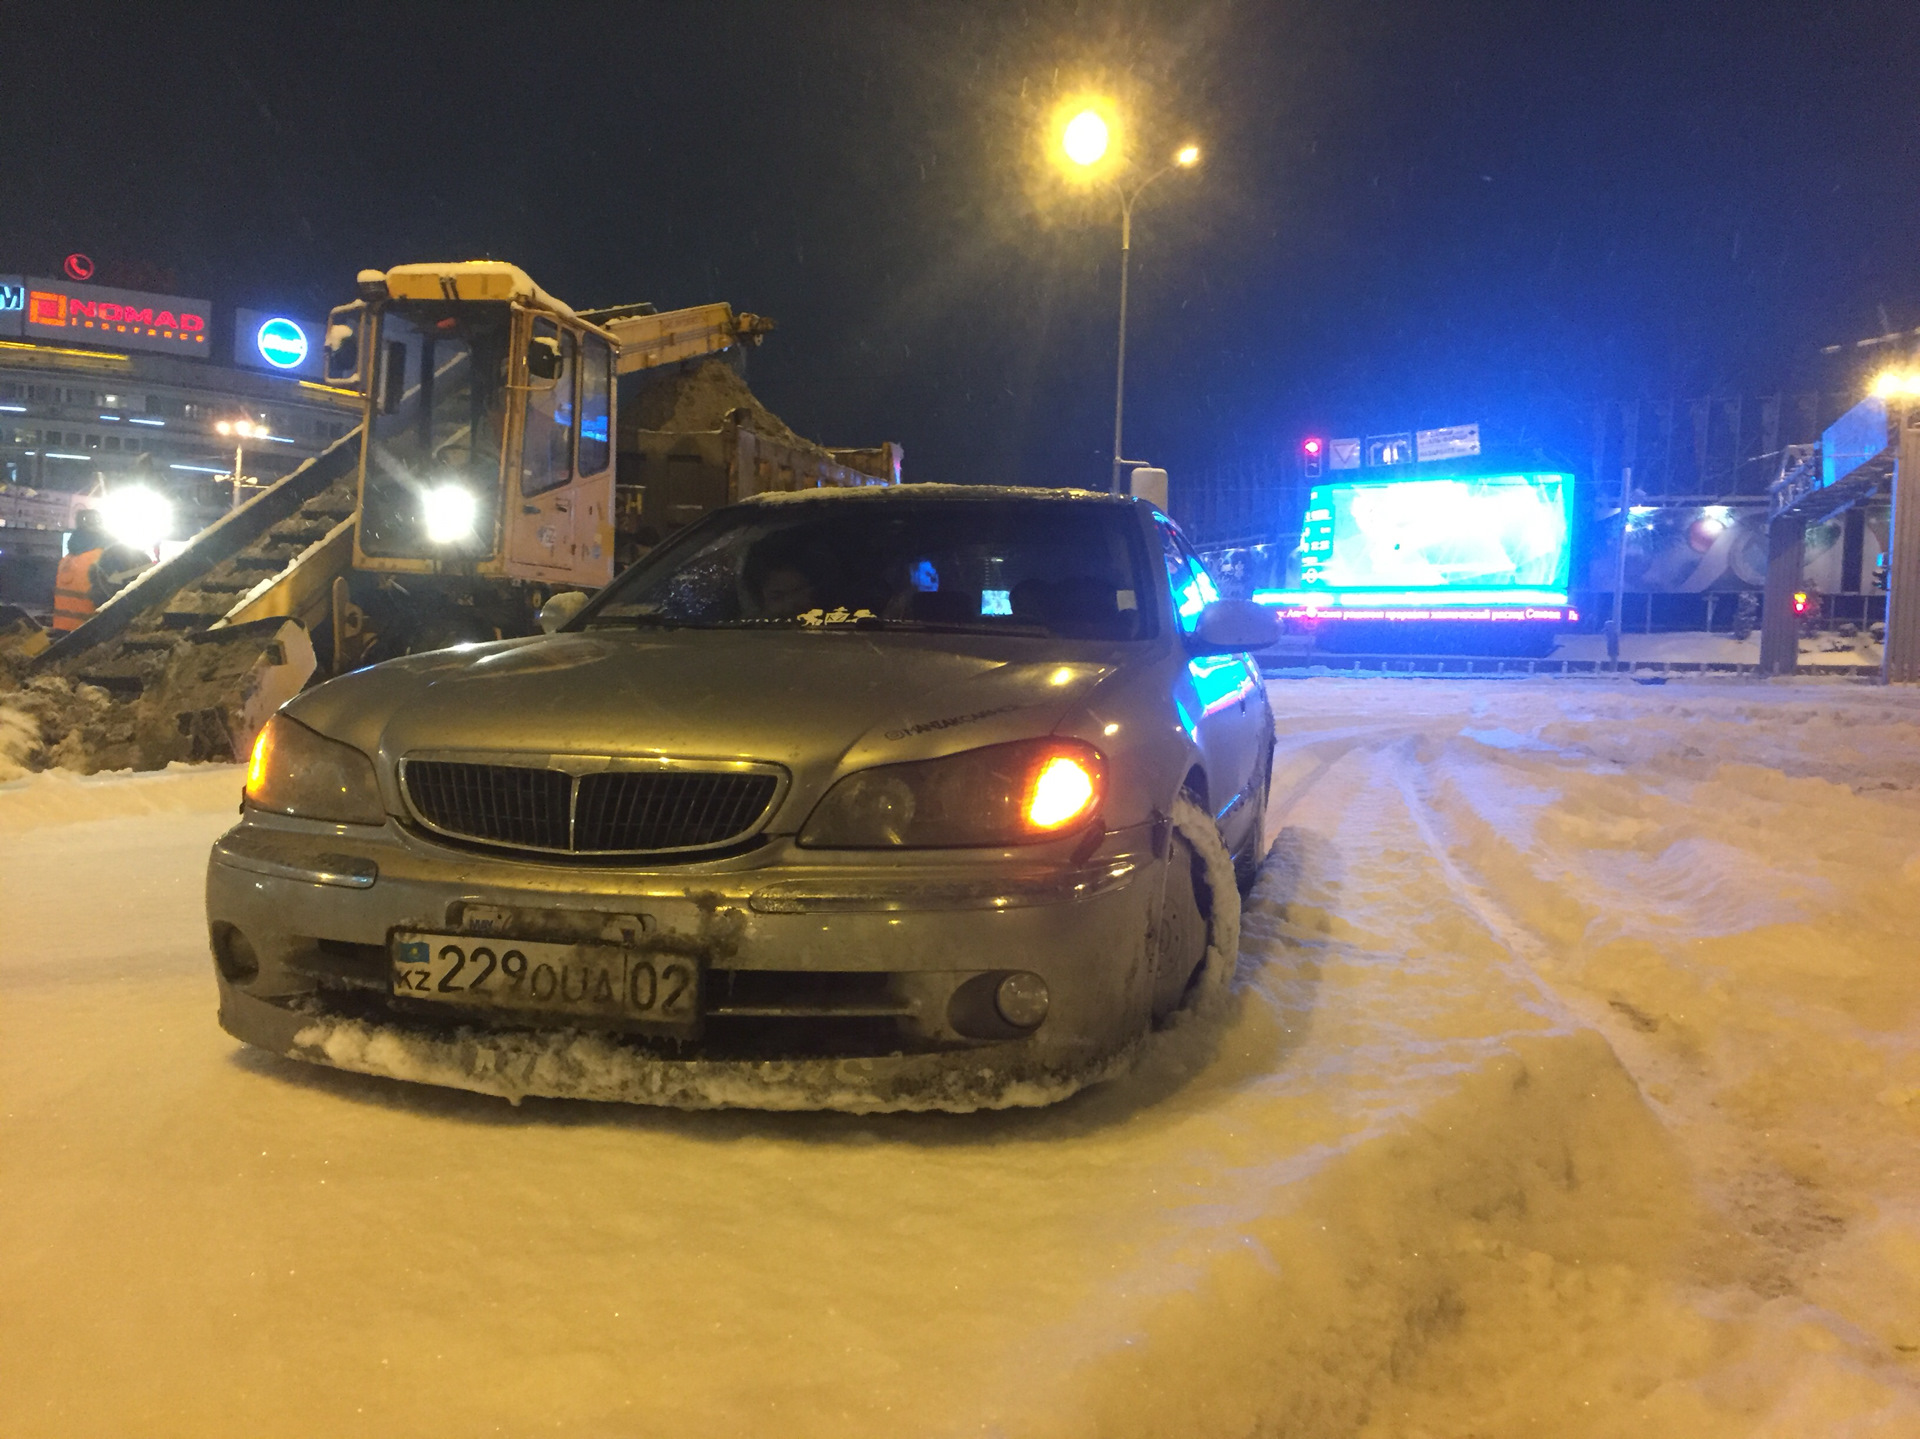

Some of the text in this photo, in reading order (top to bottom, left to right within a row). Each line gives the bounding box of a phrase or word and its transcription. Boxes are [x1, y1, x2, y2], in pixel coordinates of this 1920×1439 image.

[69, 299, 205, 332] NOMAD
[396, 969, 432, 991] KZ
[630, 961, 691, 1011] 02
